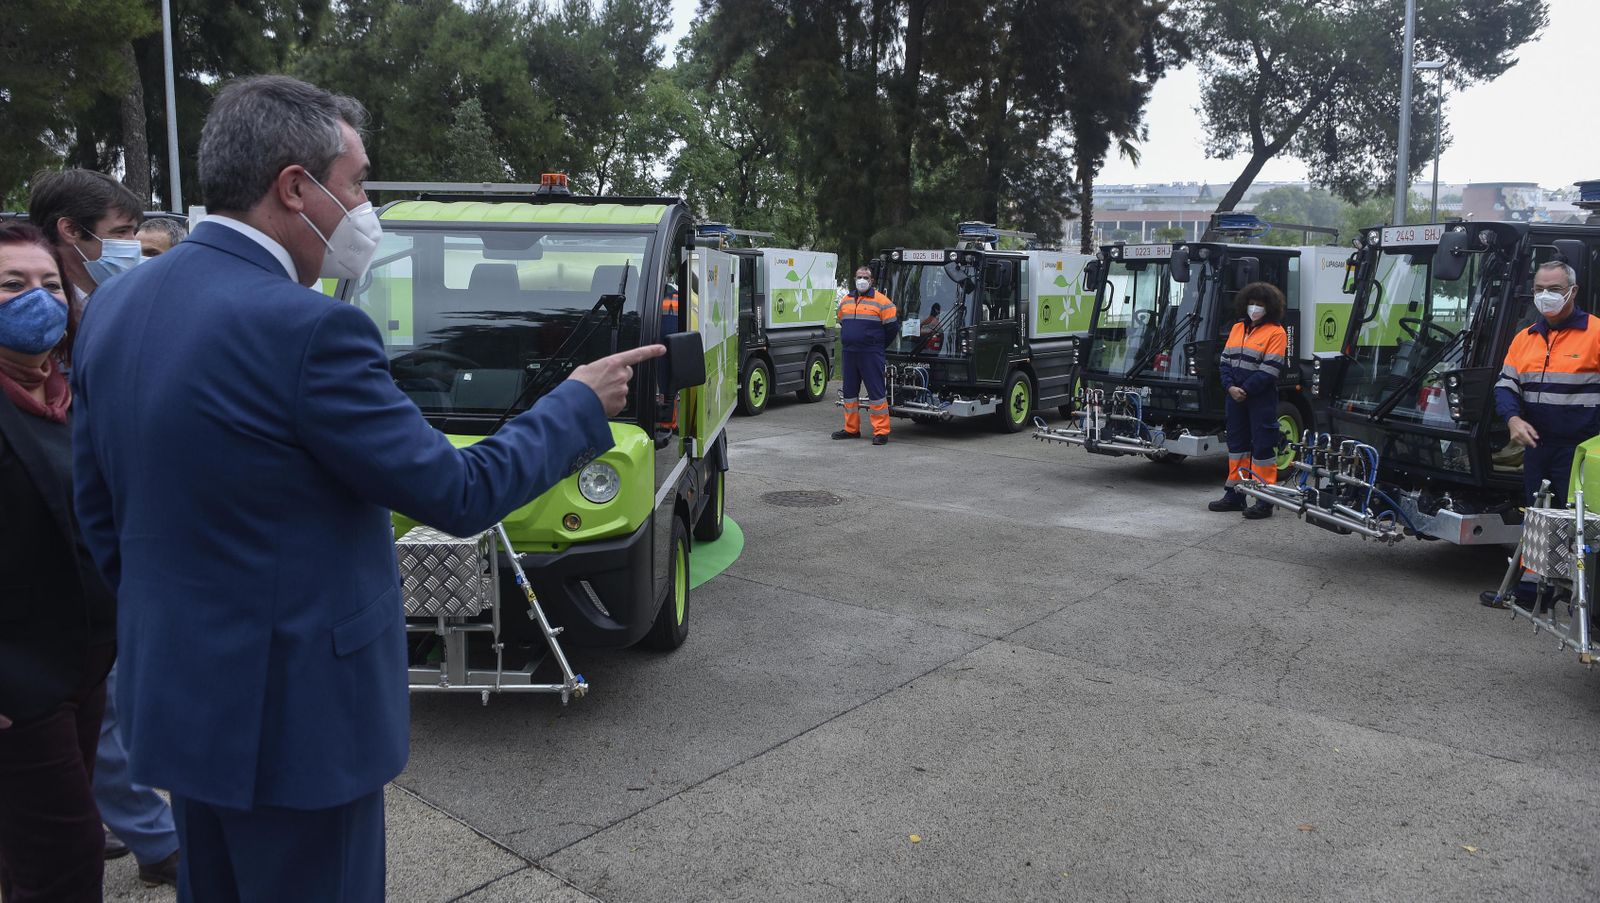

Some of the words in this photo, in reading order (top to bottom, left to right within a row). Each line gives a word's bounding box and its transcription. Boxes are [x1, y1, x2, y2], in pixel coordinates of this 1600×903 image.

[1384, 231, 1390, 243] E
[1396, 229, 1415, 242] 2449
[1424, 228, 1441, 241] BHJ
[912, 252, 927, 260] 0225
[1124, 247, 1129, 257] E
[1135, 247, 1151, 257] 0223
[1156, 246, 1171, 256] BHJ
